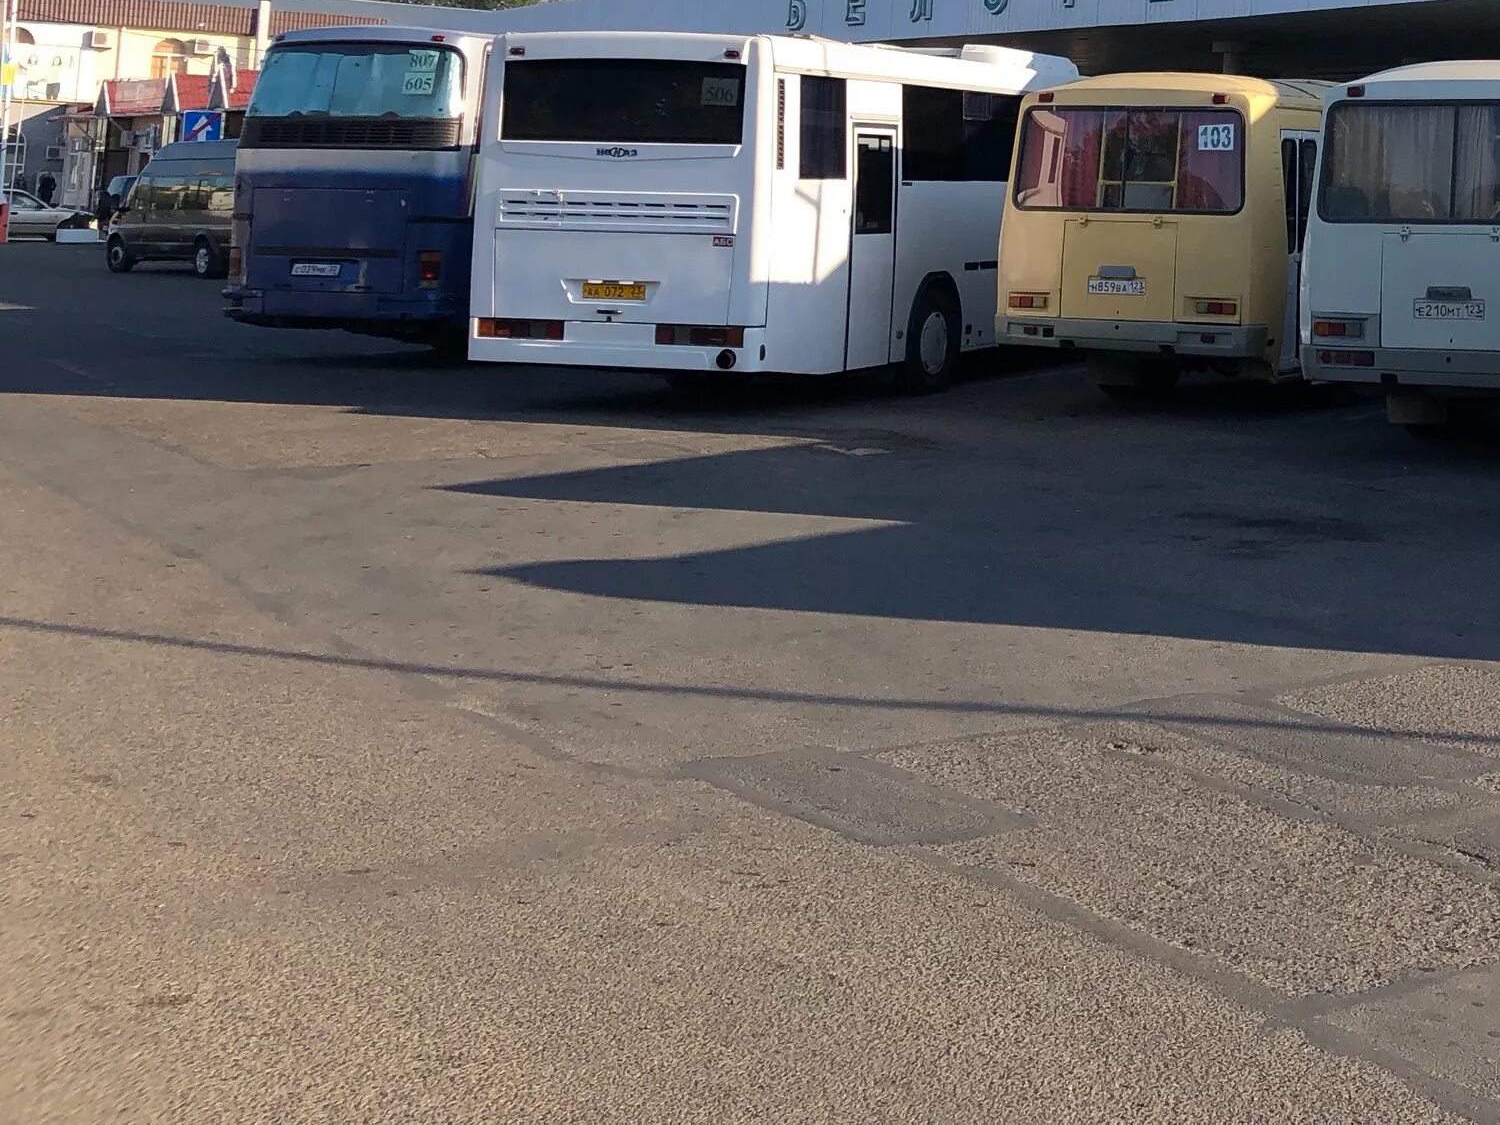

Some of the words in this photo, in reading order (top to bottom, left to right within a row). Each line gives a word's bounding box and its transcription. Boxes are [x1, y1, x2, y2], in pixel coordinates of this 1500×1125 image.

[410, 54, 435, 67] 807
[405, 77, 432, 90] 605
[705, 86, 733, 102] 506
[1200, 126, 1231, 149] 103
[1464, 304, 1482, 315] 123
